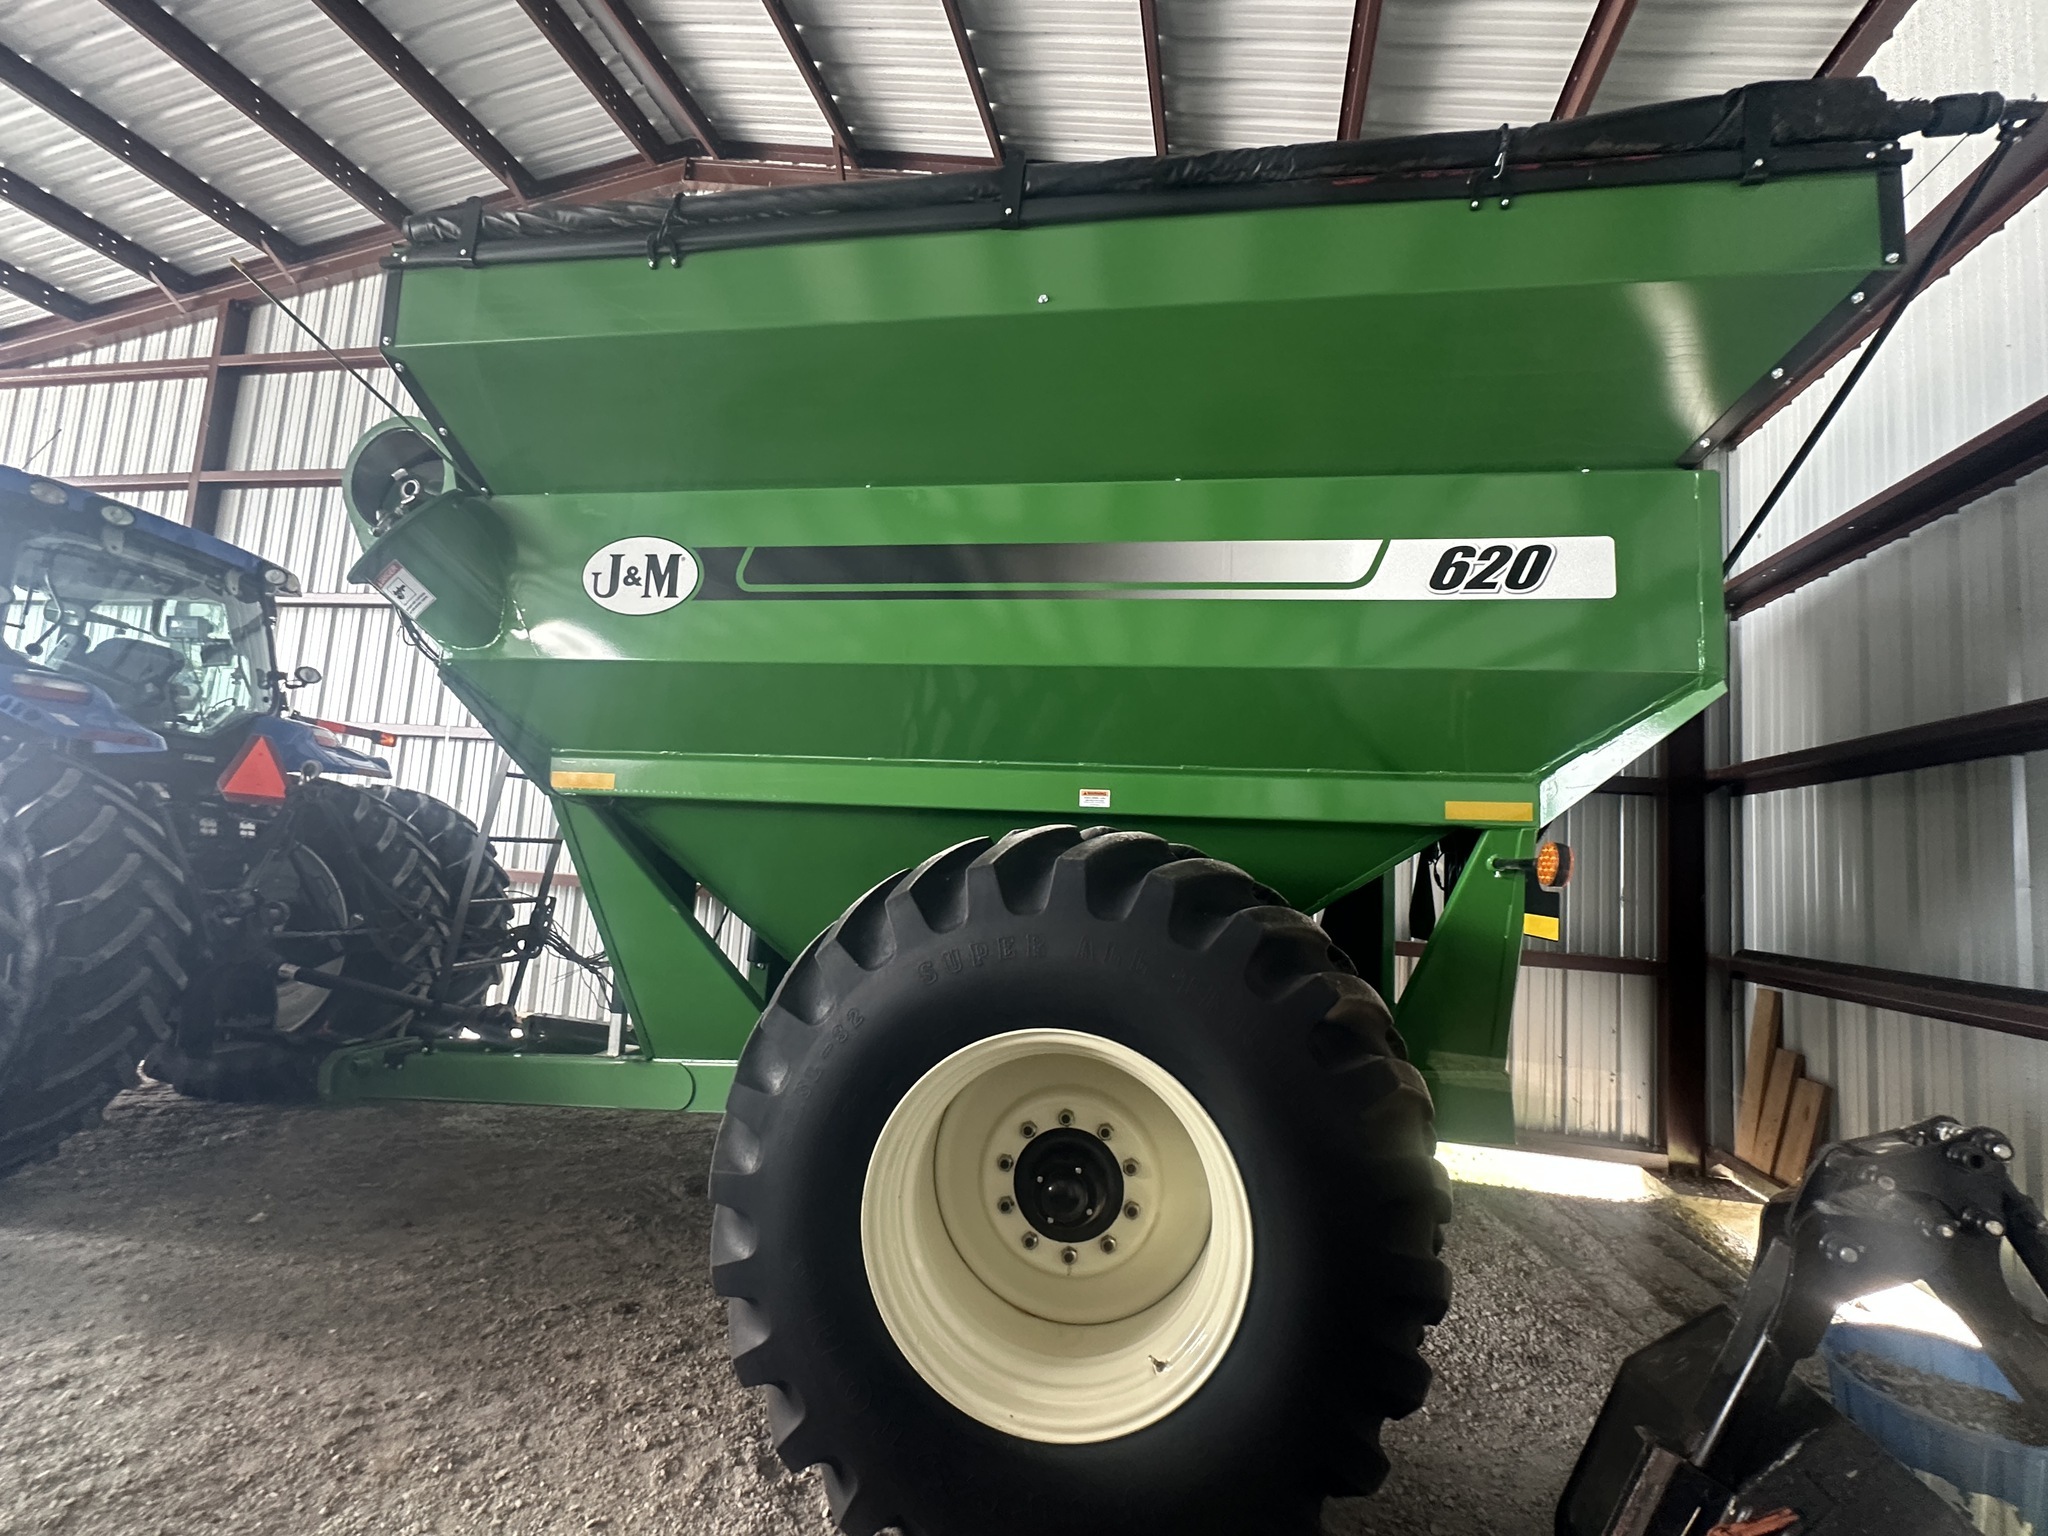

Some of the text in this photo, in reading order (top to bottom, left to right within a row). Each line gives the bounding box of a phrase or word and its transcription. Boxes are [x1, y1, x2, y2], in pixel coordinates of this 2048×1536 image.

[591, 553, 683, 599] J&M
[1428, 544, 1554, 592] 620
[916, 932, 1048, 986] SUPER
